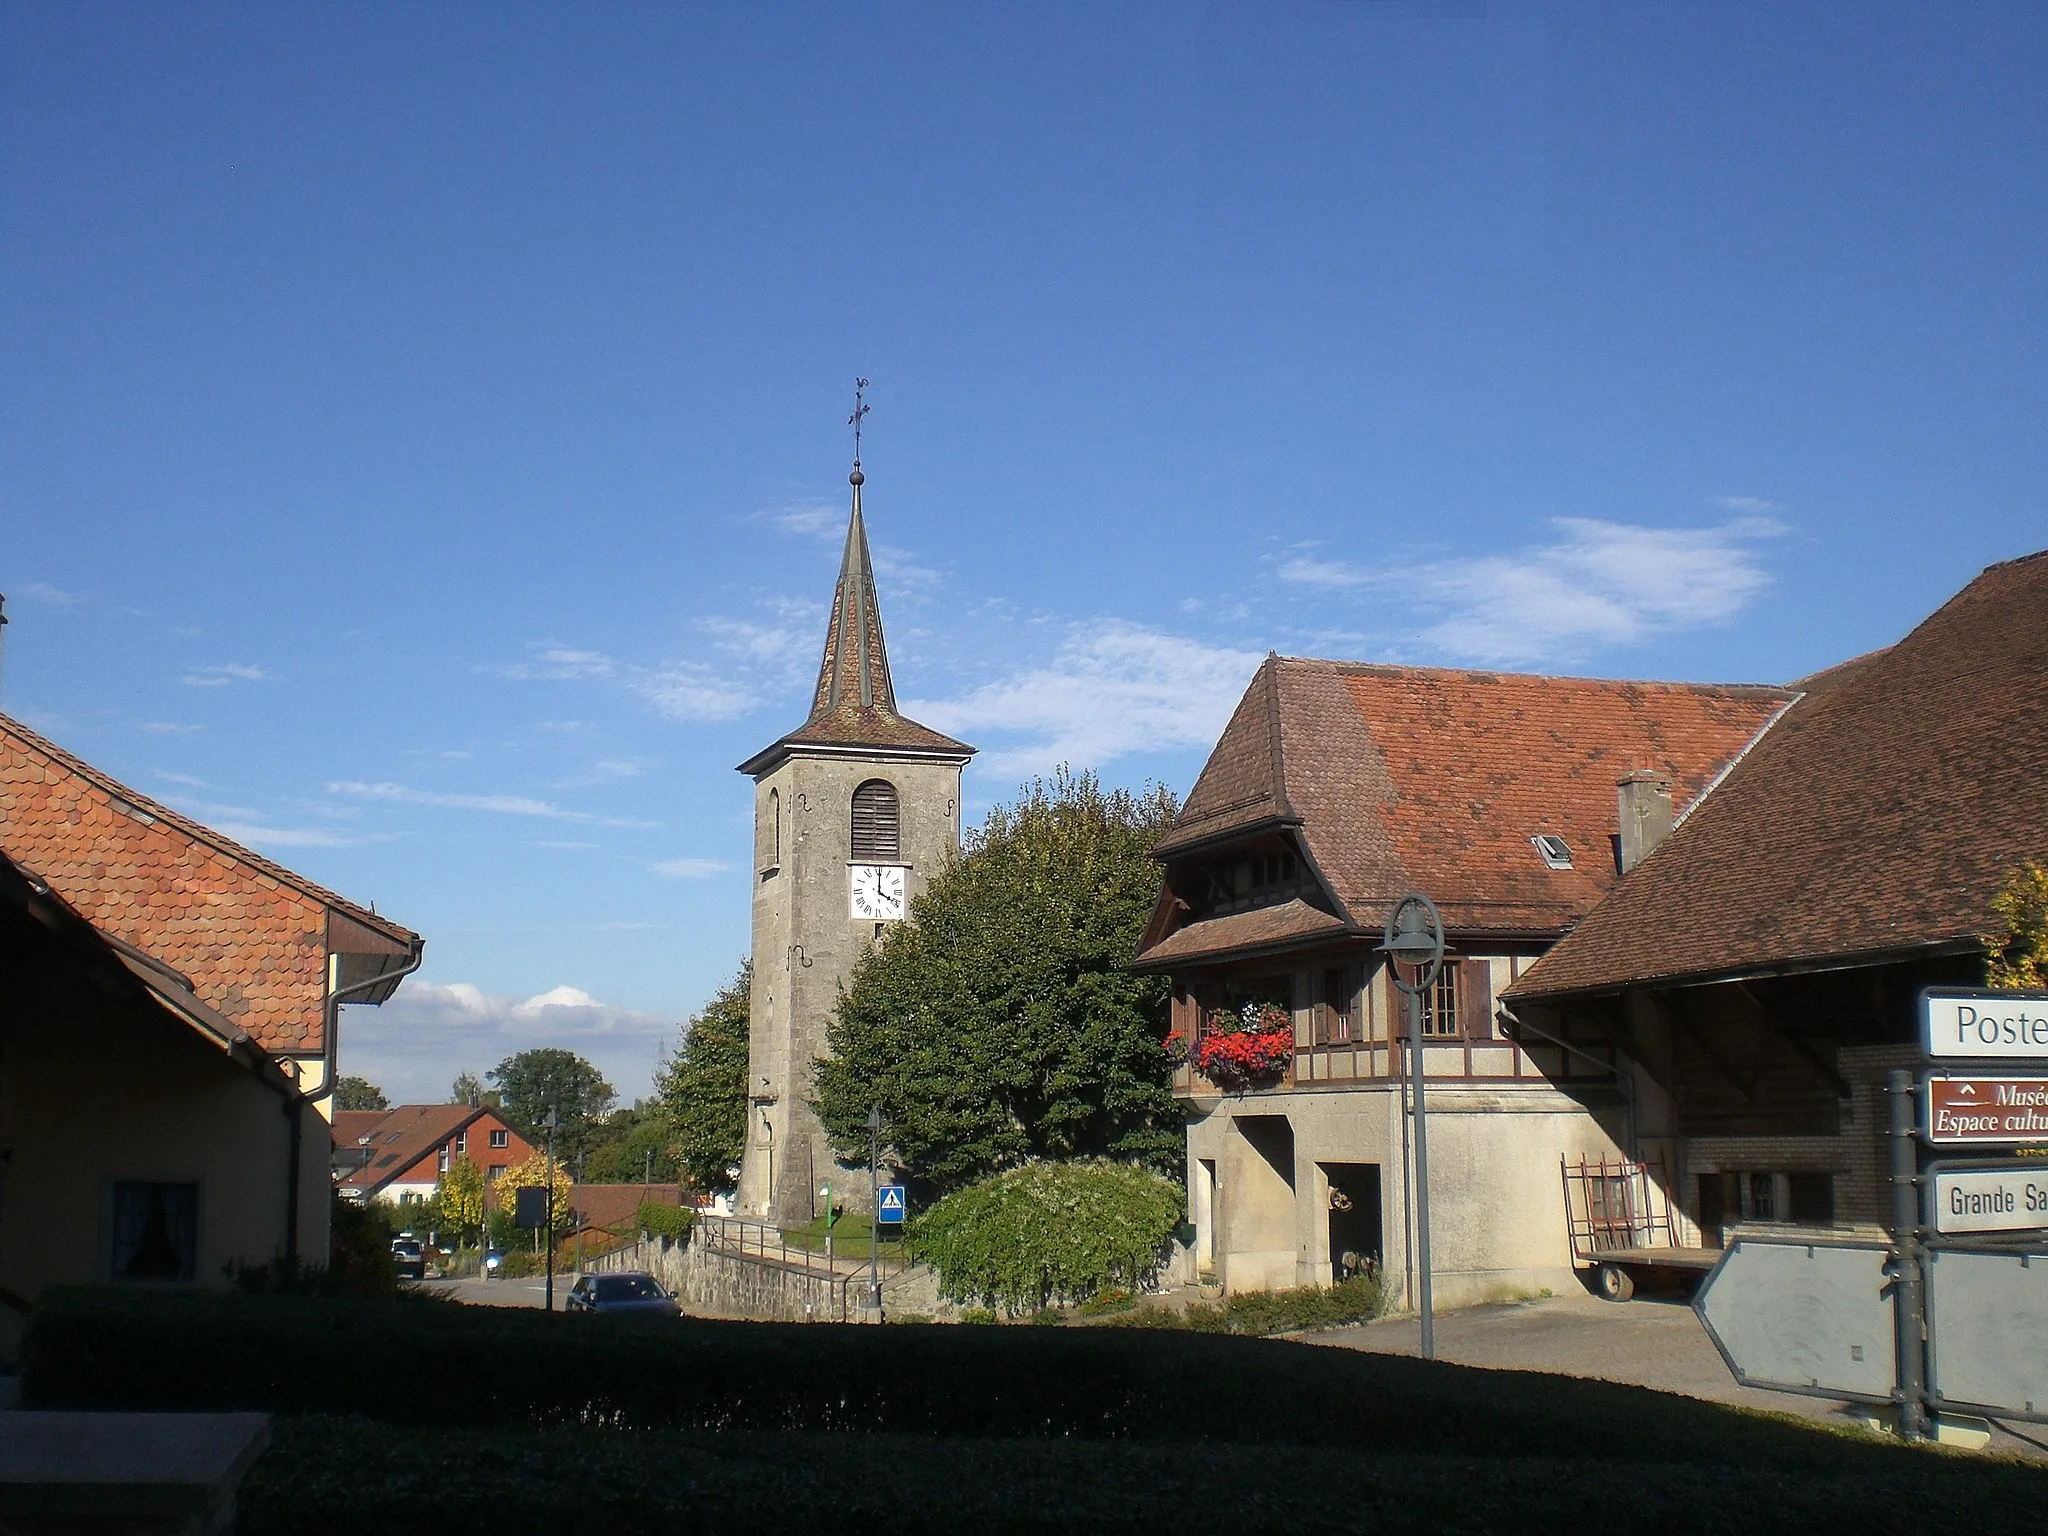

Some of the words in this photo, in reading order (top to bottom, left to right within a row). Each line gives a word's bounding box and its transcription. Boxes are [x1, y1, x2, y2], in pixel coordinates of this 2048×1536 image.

[1957, 1005, 2048, 1044] Poste
[1936, 1109, 1999, 1136] Espace
[1951, 1185, 2014, 1215] Grande
[2025, 1183, 2048, 1211] Sa
